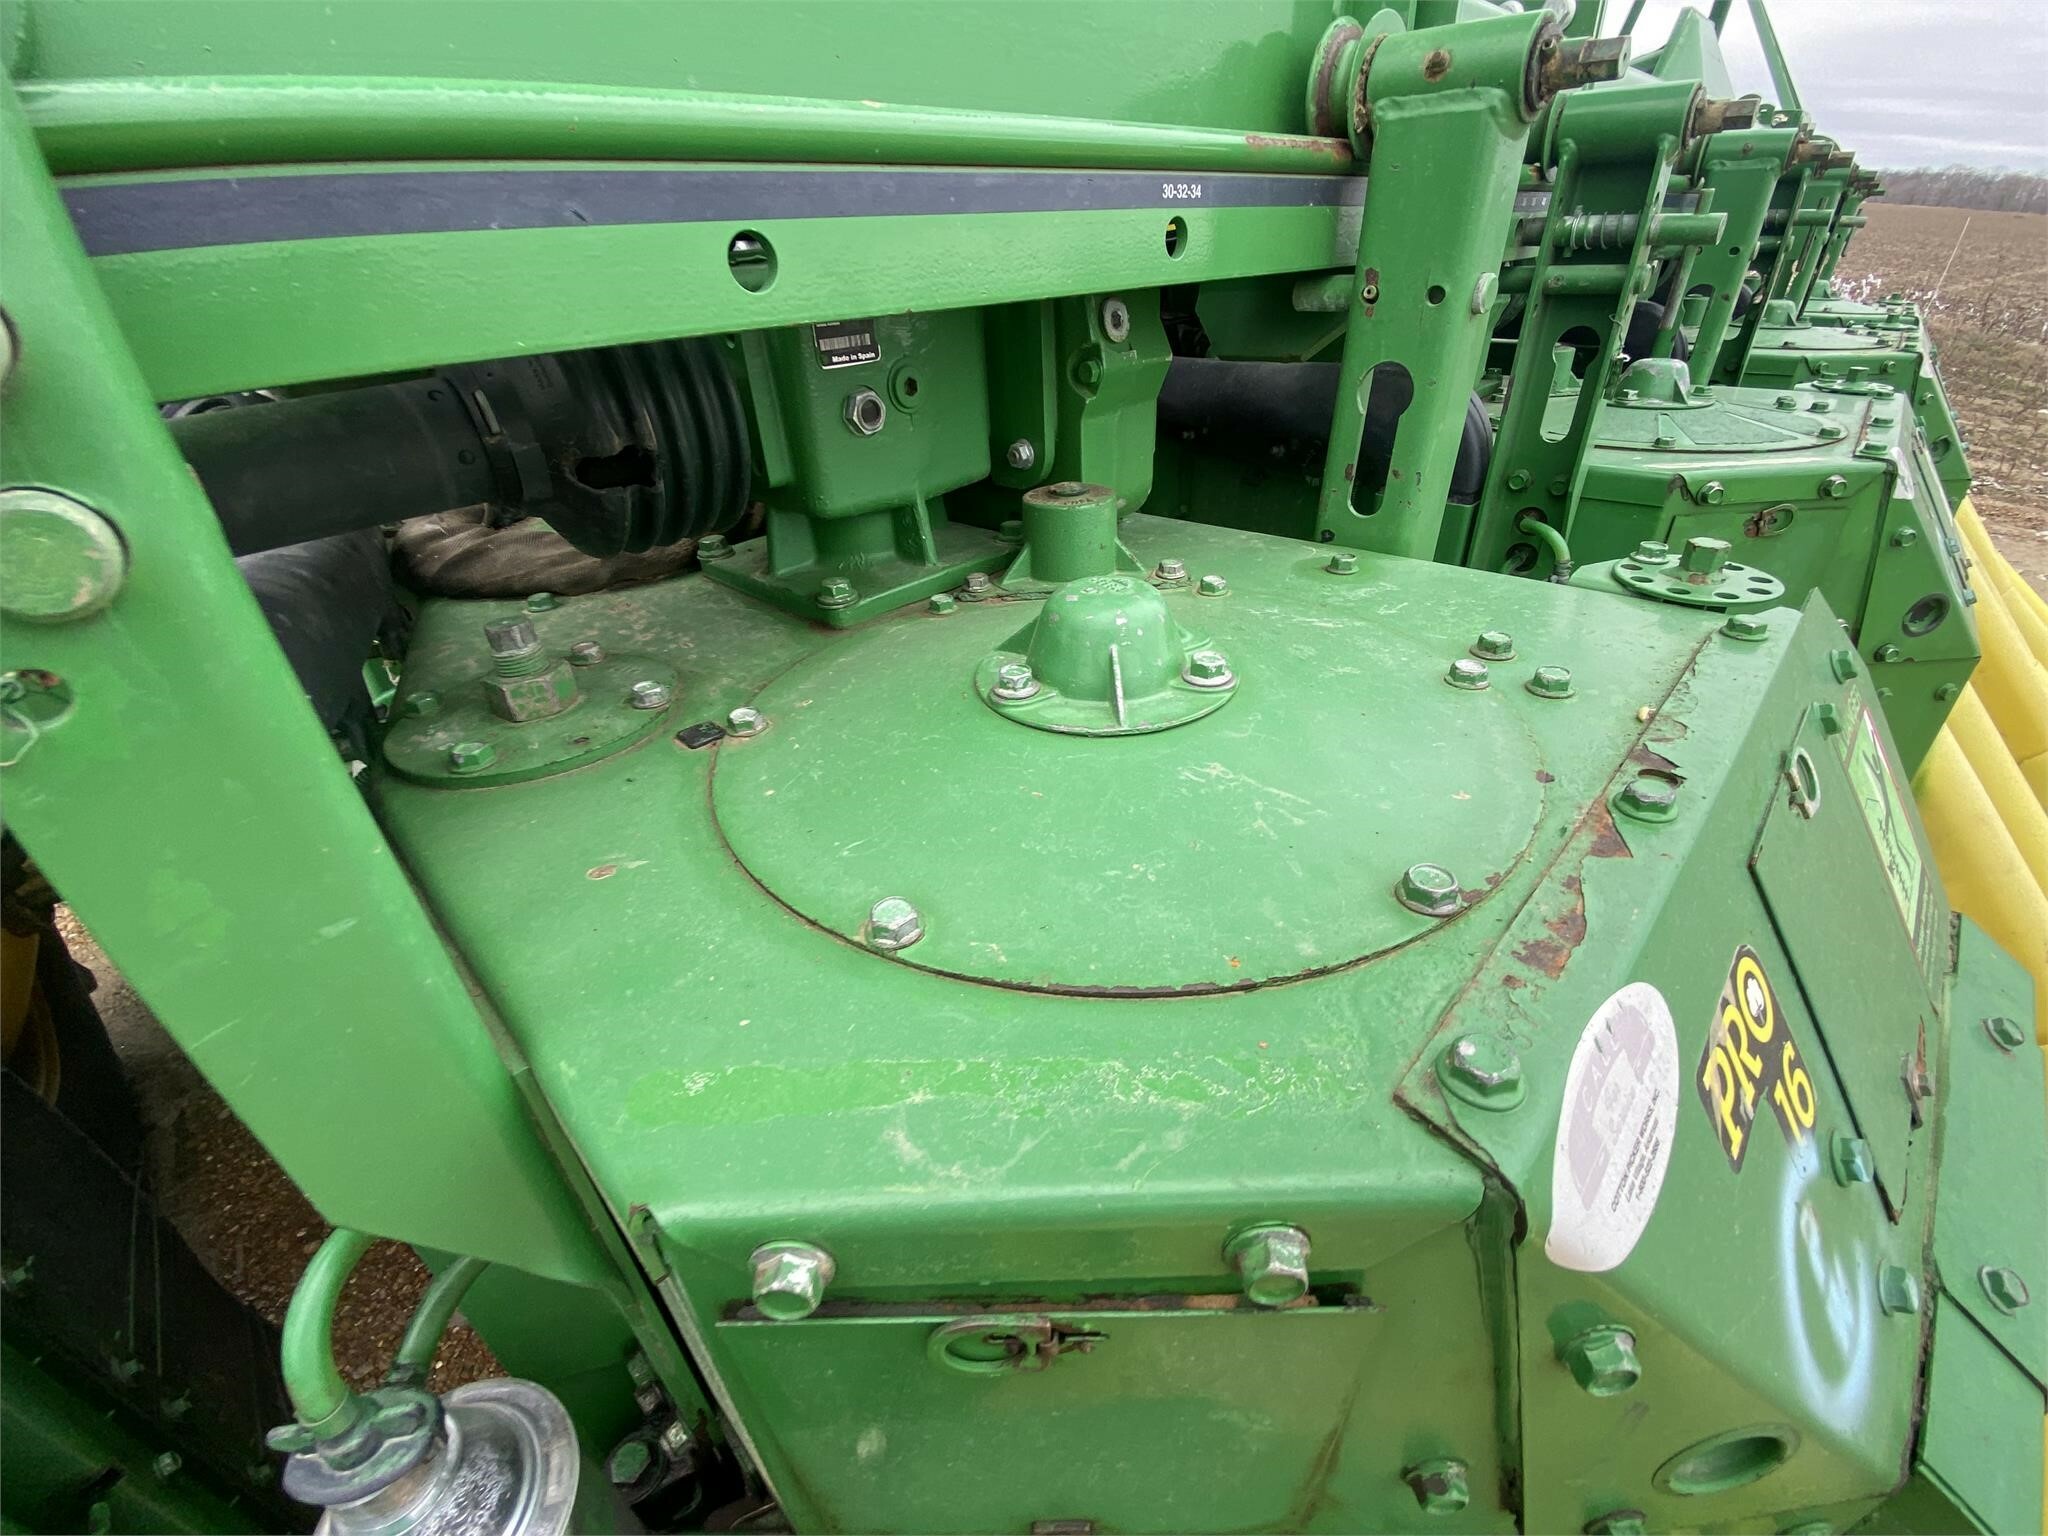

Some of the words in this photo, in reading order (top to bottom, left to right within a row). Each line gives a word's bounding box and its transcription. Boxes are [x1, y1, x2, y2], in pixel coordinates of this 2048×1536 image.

[1162, 183, 1202, 199] 30-32-34
[857, 352, 876, 360] Spain
[1702, 956, 1774, 1161] PRO
[1774, 1040, 1815, 1147] 16
